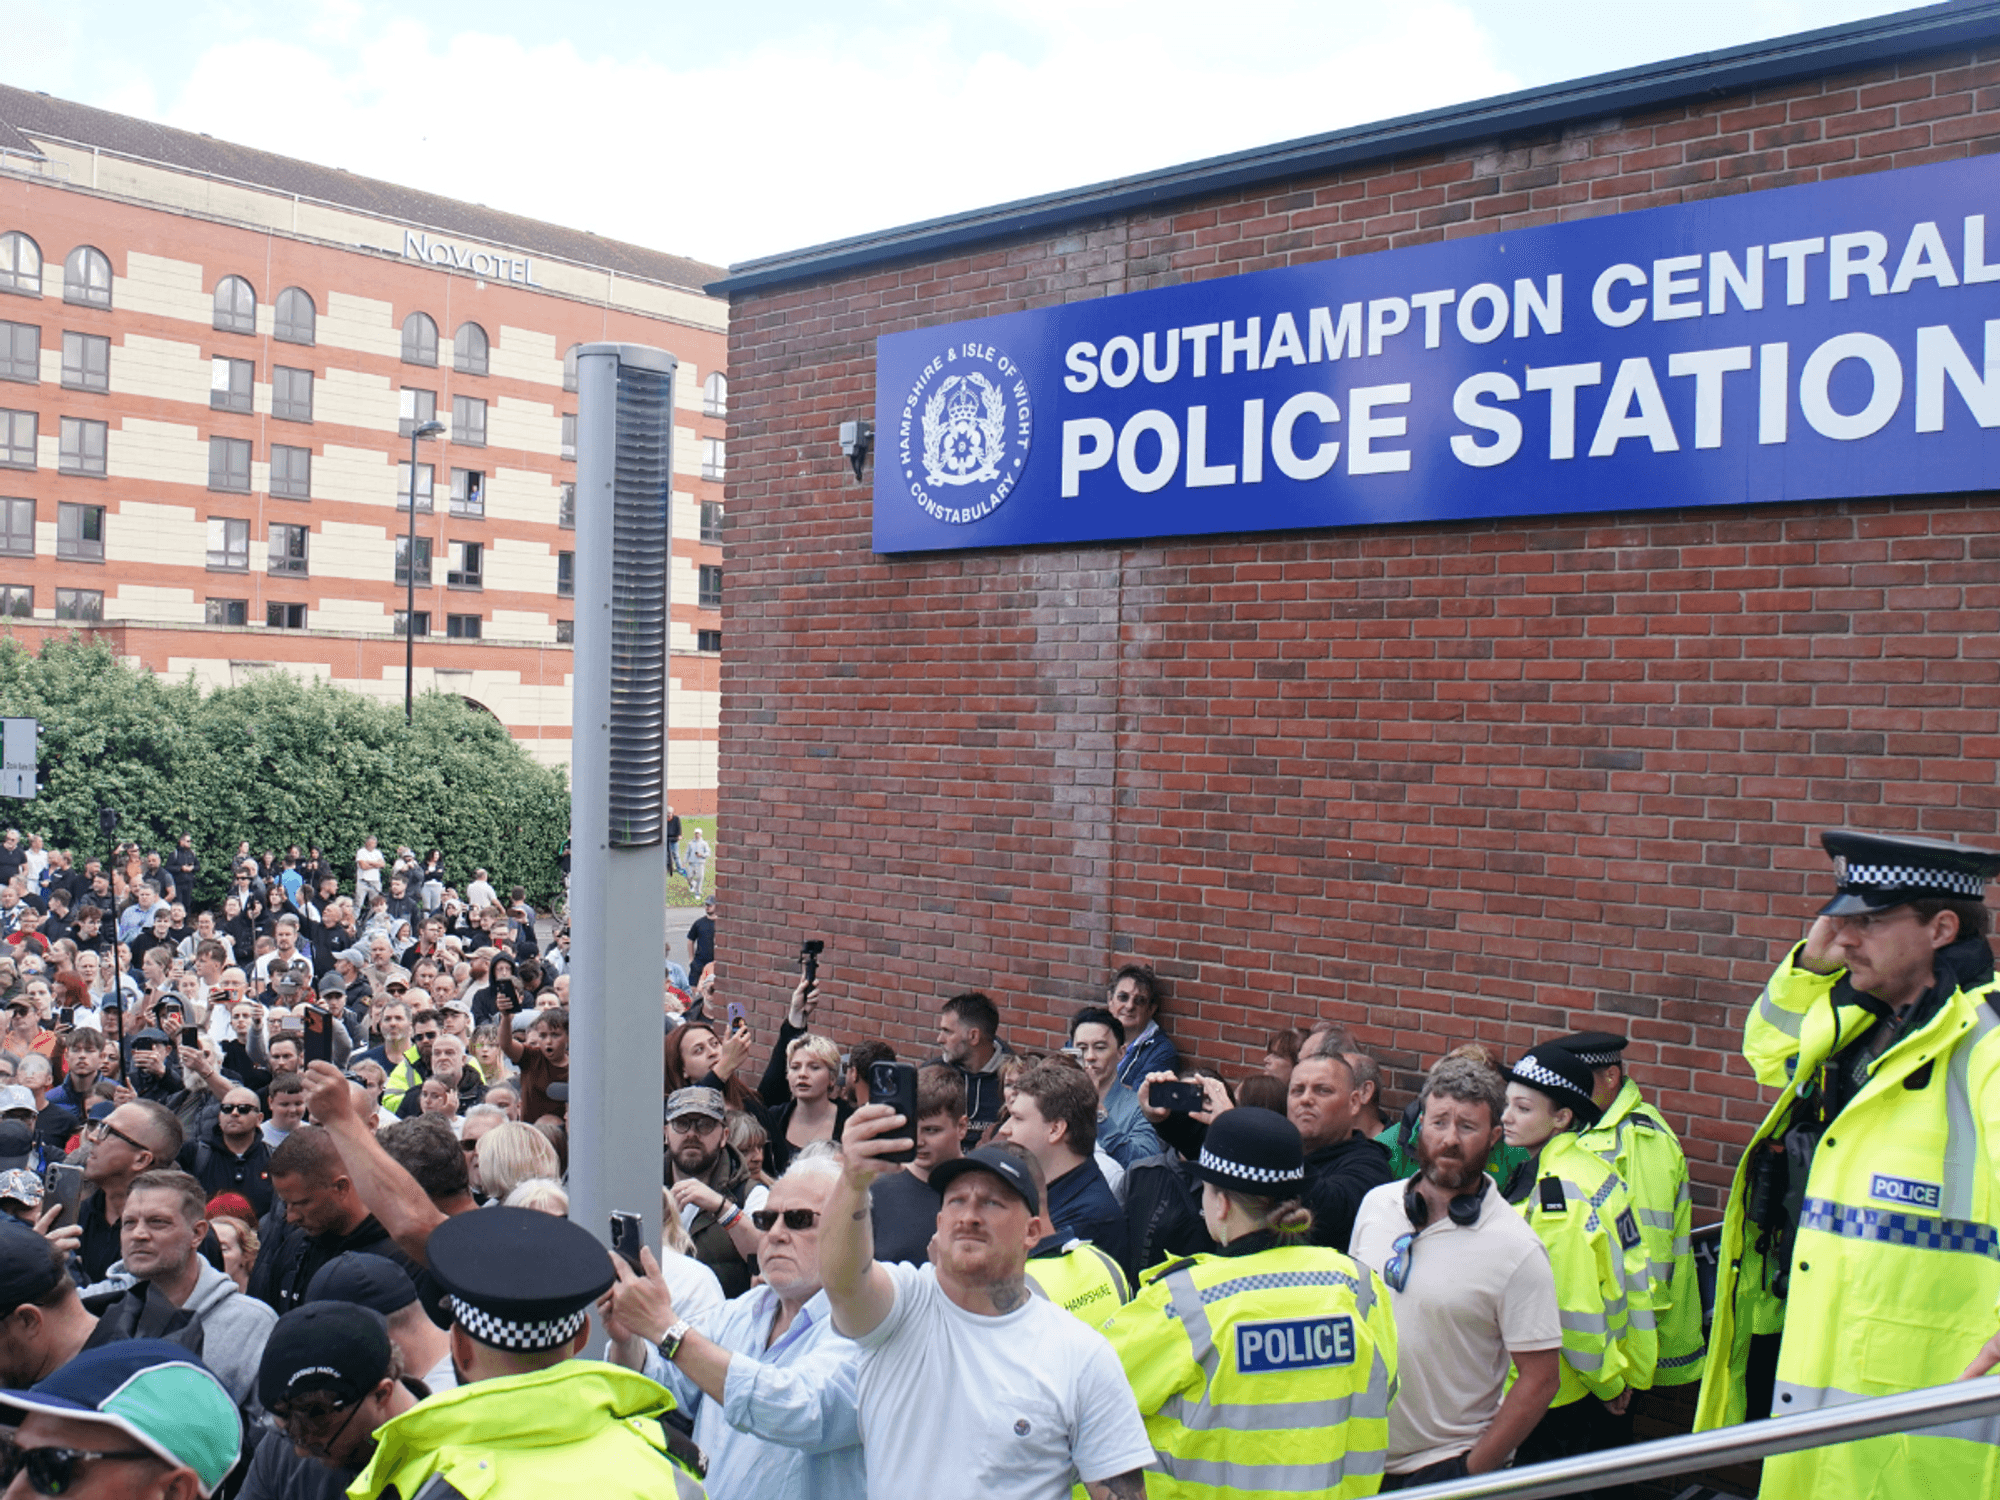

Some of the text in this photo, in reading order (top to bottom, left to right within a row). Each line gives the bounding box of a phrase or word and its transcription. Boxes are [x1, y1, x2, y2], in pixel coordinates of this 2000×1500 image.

[403, 230, 543, 287] NOVOTEL
[1064, 214, 2000, 393] SOUTHAMPTON CENTRAL
[900, 343, 1031, 465] HAMPSHIRE & ISLE OF WIGHT
[1061, 319, 2000, 498] POLICE STATION
[910, 471, 1015, 523] CONSTABULARY
[1875, 1178, 1937, 1205] POLICE
[1241, 1321, 1352, 1367] POLICE
